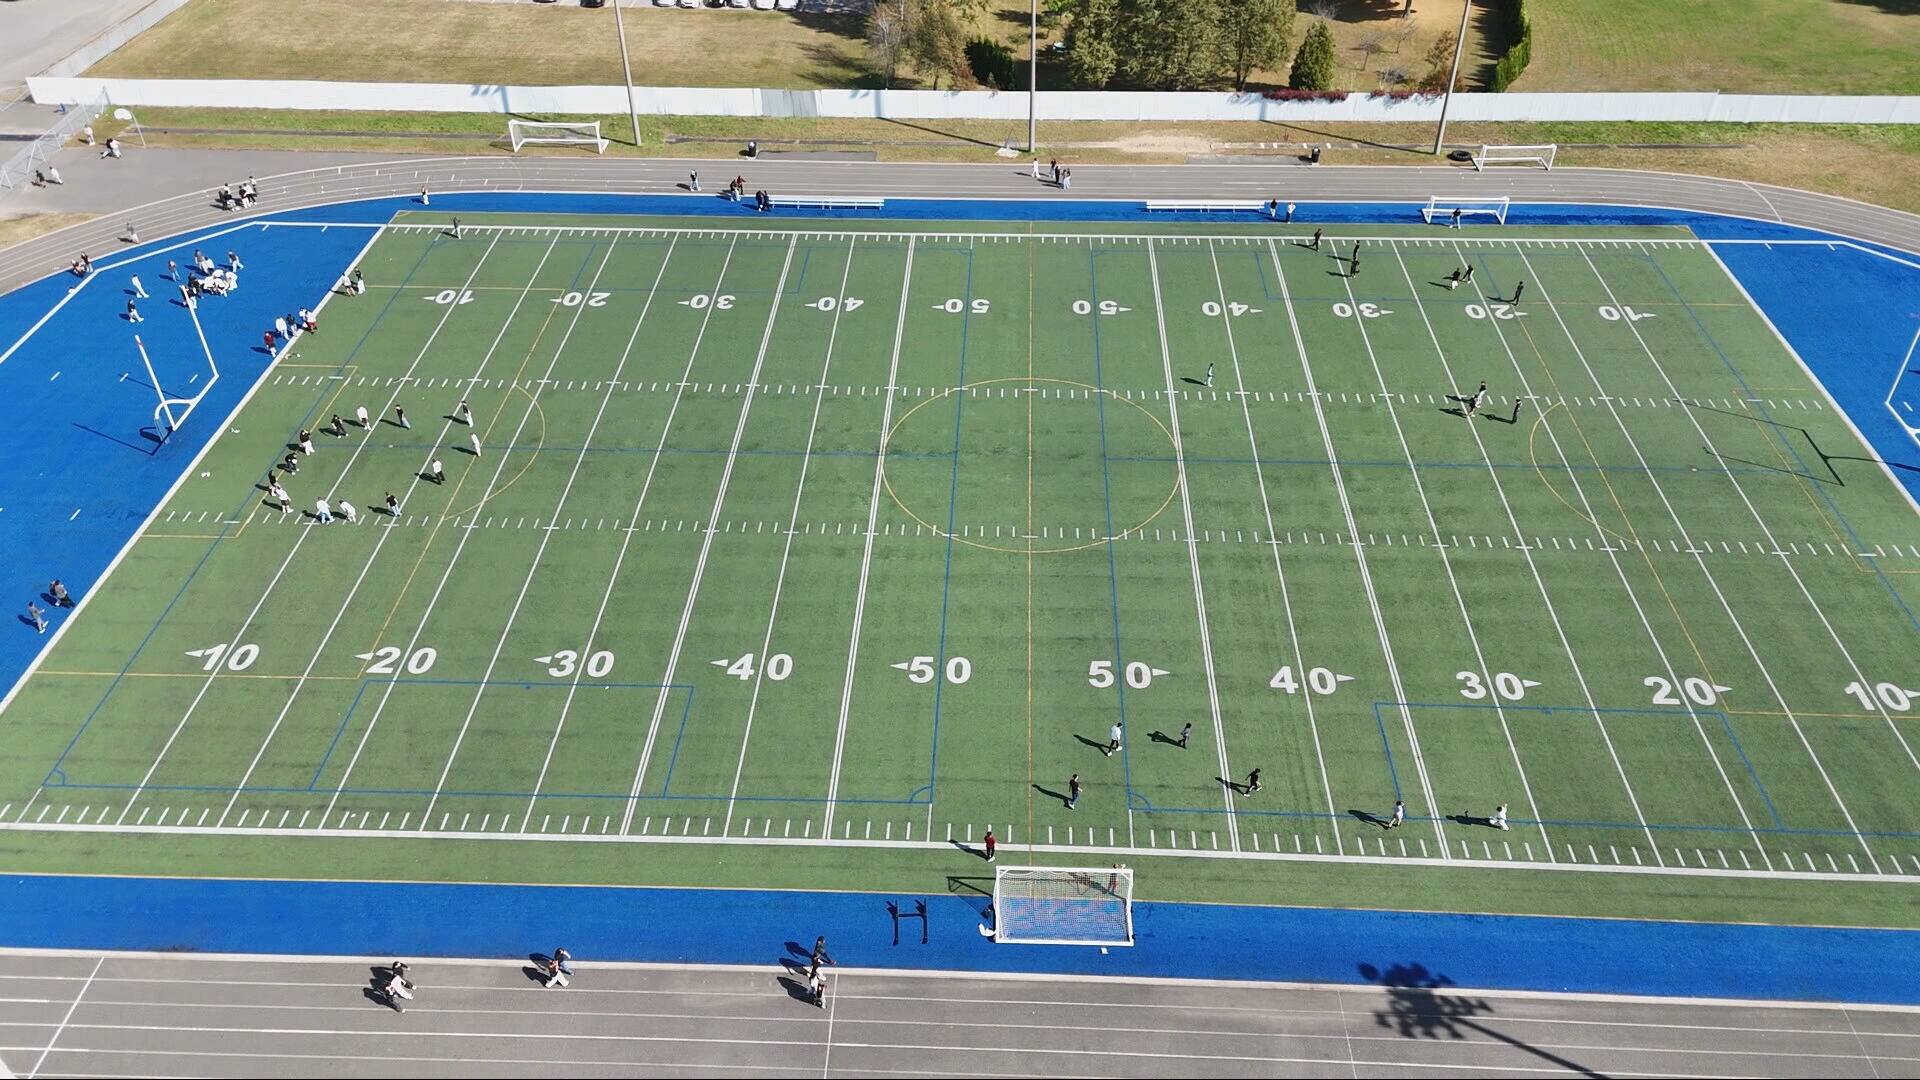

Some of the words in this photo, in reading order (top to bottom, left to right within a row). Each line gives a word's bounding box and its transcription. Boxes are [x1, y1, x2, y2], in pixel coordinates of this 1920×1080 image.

[435, 290, 474, 305] 10
[562, 292, 611, 307] 20
[690, 294, 736, 309] 30
[817, 297, 864, 312] 40
[944, 298, 990, 313] 50
[1072, 300, 1118, 315] 50
[1201, 301, 1248, 316] 40
[1332, 302, 1380, 318] 30
[1464, 304, 1515, 320] 20
[1598, 305, 1642, 322] 10
[203, 643, 260, 671] 10
[365, 647, 437, 674] 20
[548, 650, 615, 678] 30
[726, 653, 793, 681] 40
[908, 656, 972, 684] 50
[1088, 660, 1152, 689] 50
[1270, 665, 1336, 695] 40
[1456, 671, 1525, 701] 30
[1644, 676, 1717, 706] 20
[1845, 681, 1911, 711] 10
